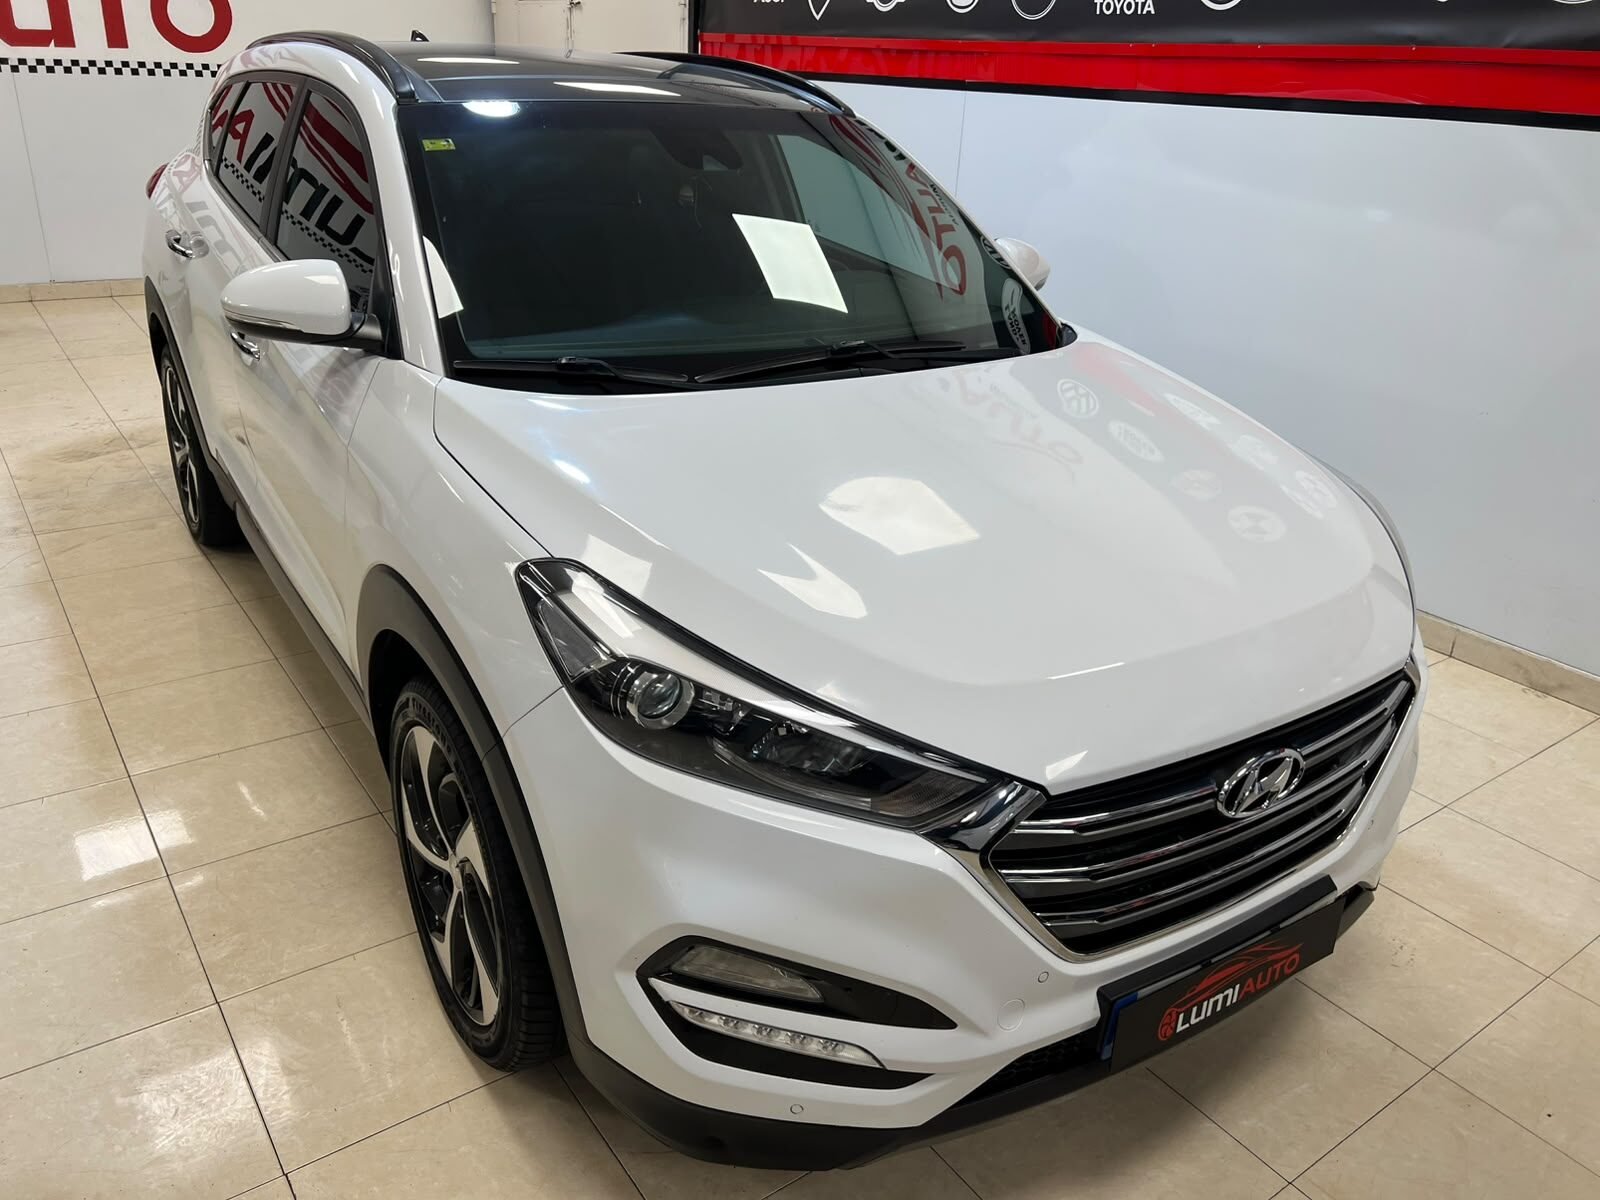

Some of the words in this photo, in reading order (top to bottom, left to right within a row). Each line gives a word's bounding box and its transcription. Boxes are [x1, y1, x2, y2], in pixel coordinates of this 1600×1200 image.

[1094, 0, 1155, 15] TOYOTA
[1176, 983, 1240, 1033] LUMI
[1239, 953, 1300, 1000] AUTO
